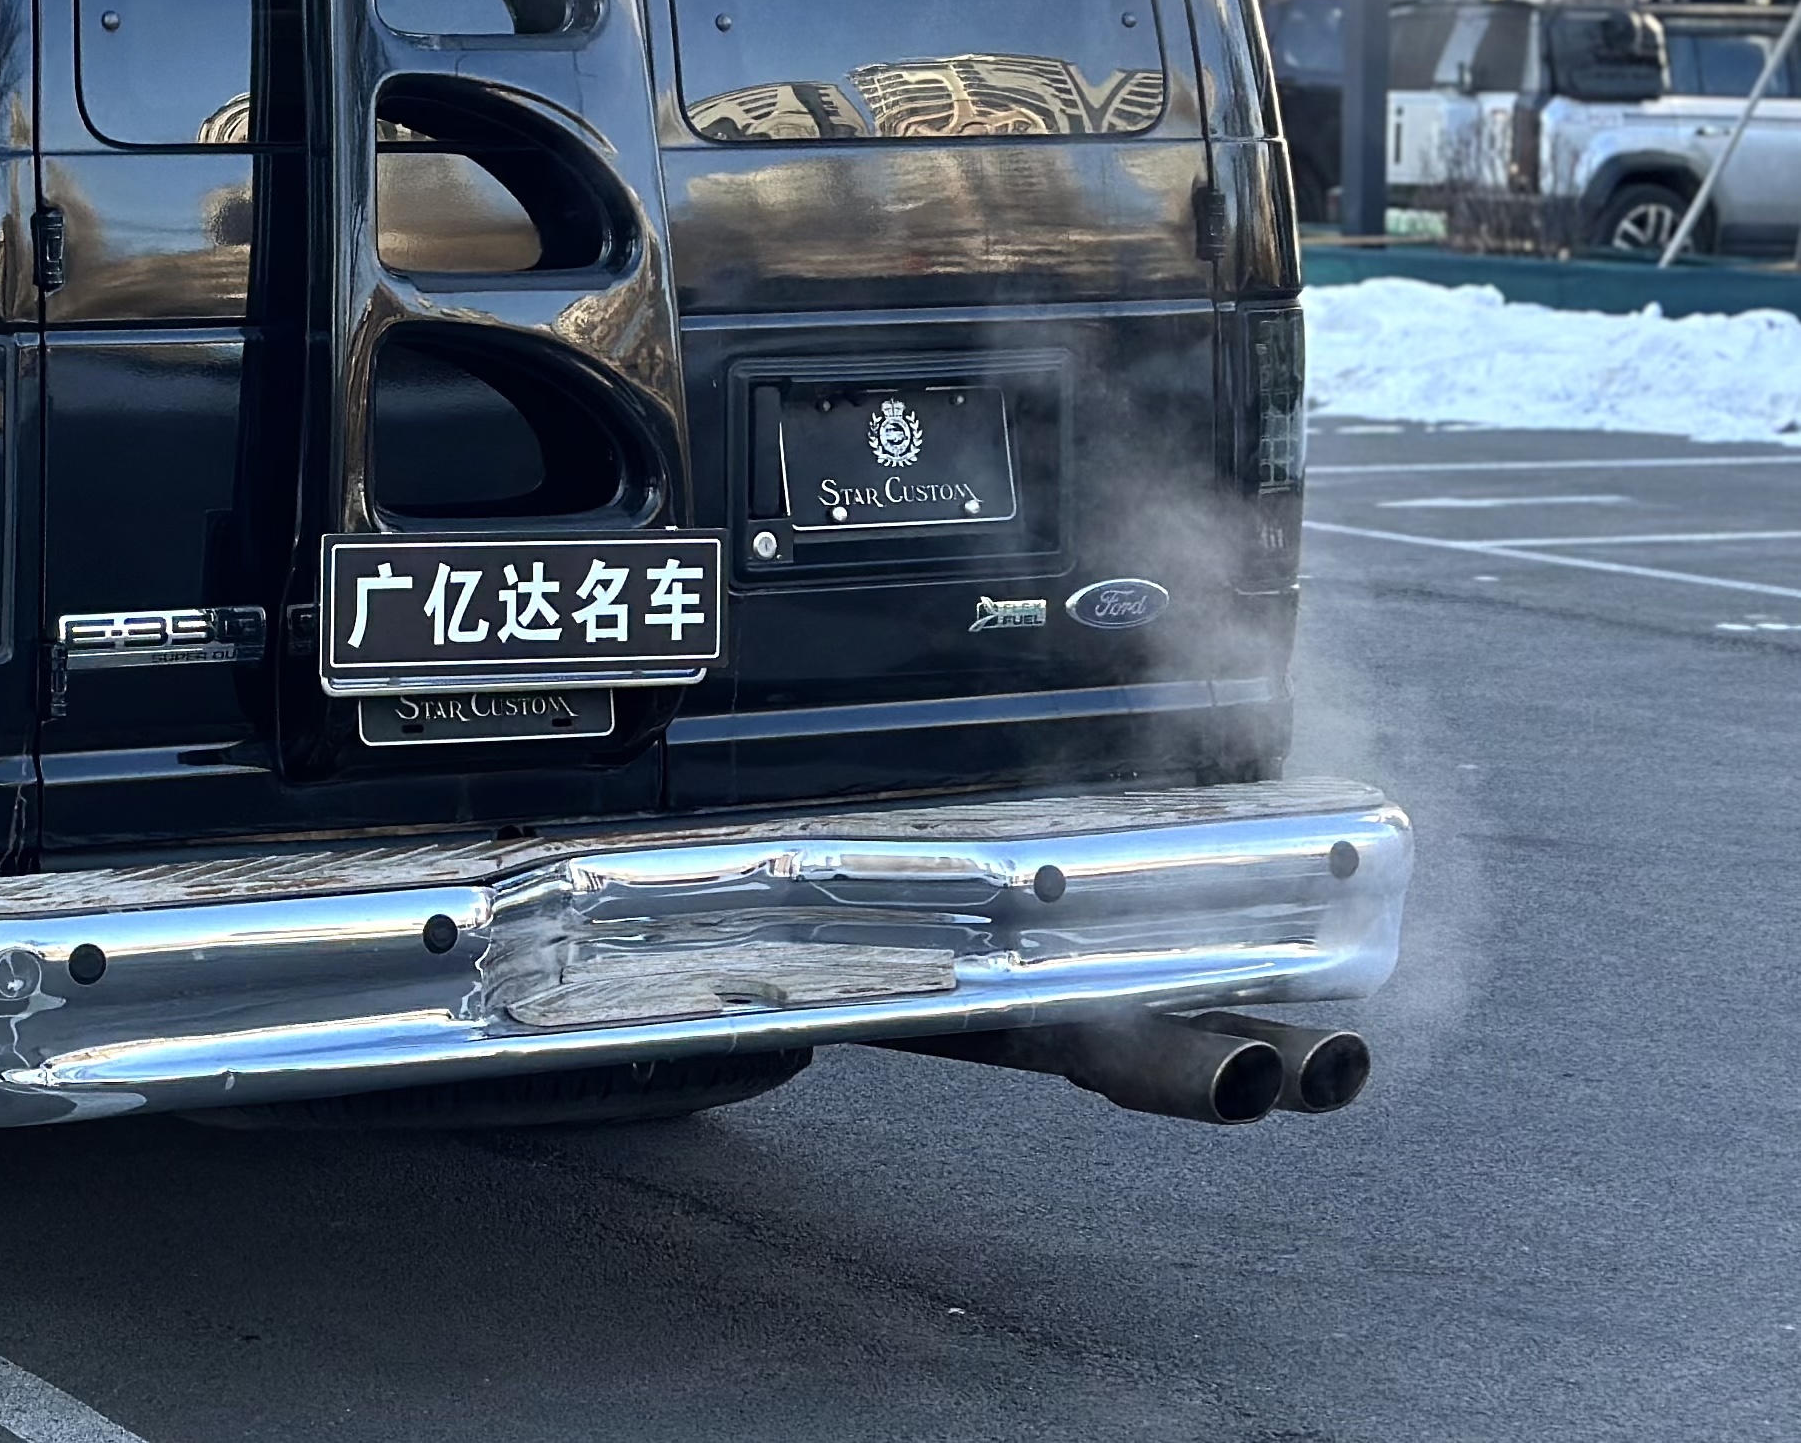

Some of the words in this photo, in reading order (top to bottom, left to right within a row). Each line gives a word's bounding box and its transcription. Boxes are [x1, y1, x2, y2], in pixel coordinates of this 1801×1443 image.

[347, 558, 705, 648] 广亿达名车
[1094, 589, 1149, 618] Ford
[1002, 614, 1043, 625] FUEL
[151, 651, 207, 663] SUPER
